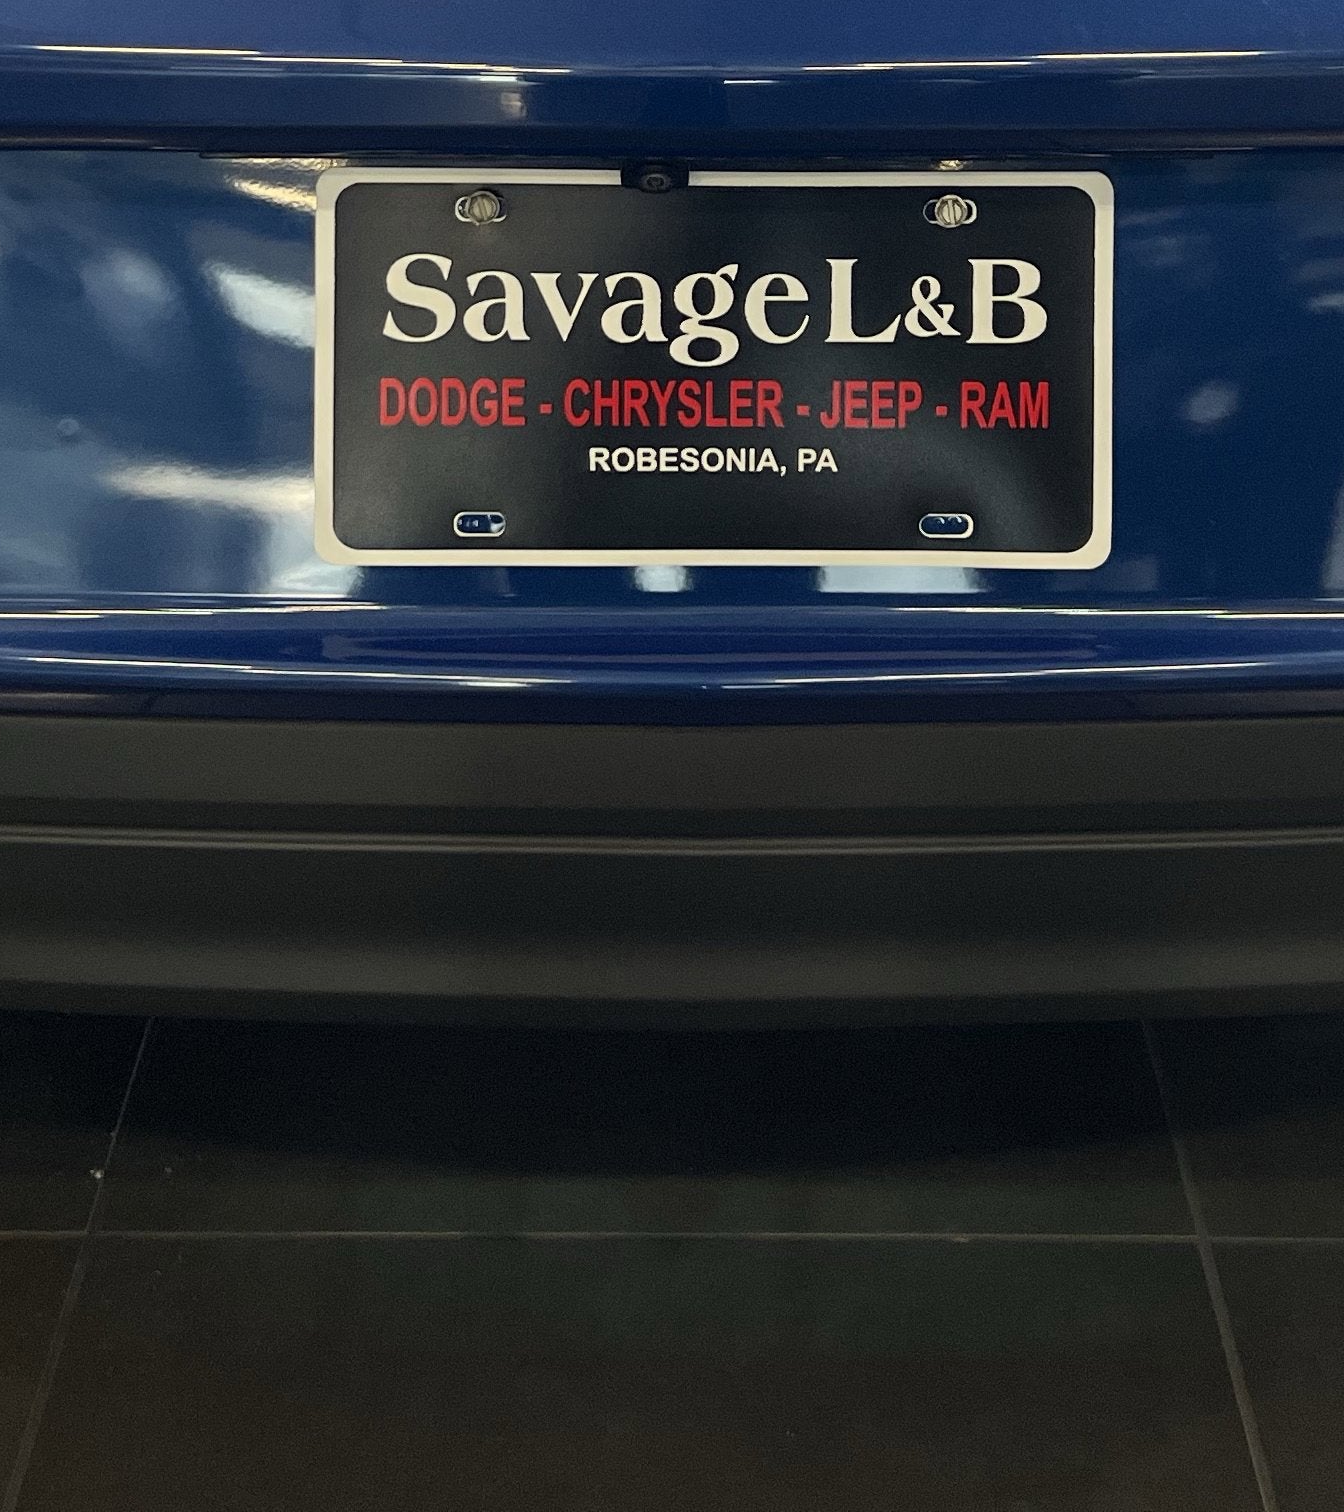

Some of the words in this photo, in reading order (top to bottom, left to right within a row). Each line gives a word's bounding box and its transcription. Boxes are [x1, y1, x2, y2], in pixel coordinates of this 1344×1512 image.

[382, 253, 810, 367] Savage
[824, 258, 1048, 344] L&B
[378, 376, 527, 427] DODGE
[562, 377, 784, 429] CHRYSLER
[819, 379, 924, 429] JEEP
[959, 379, 1050, 429] RAM
[588, 446, 787, 477] ROBESONIA,
[797, 447, 839, 473] PA
